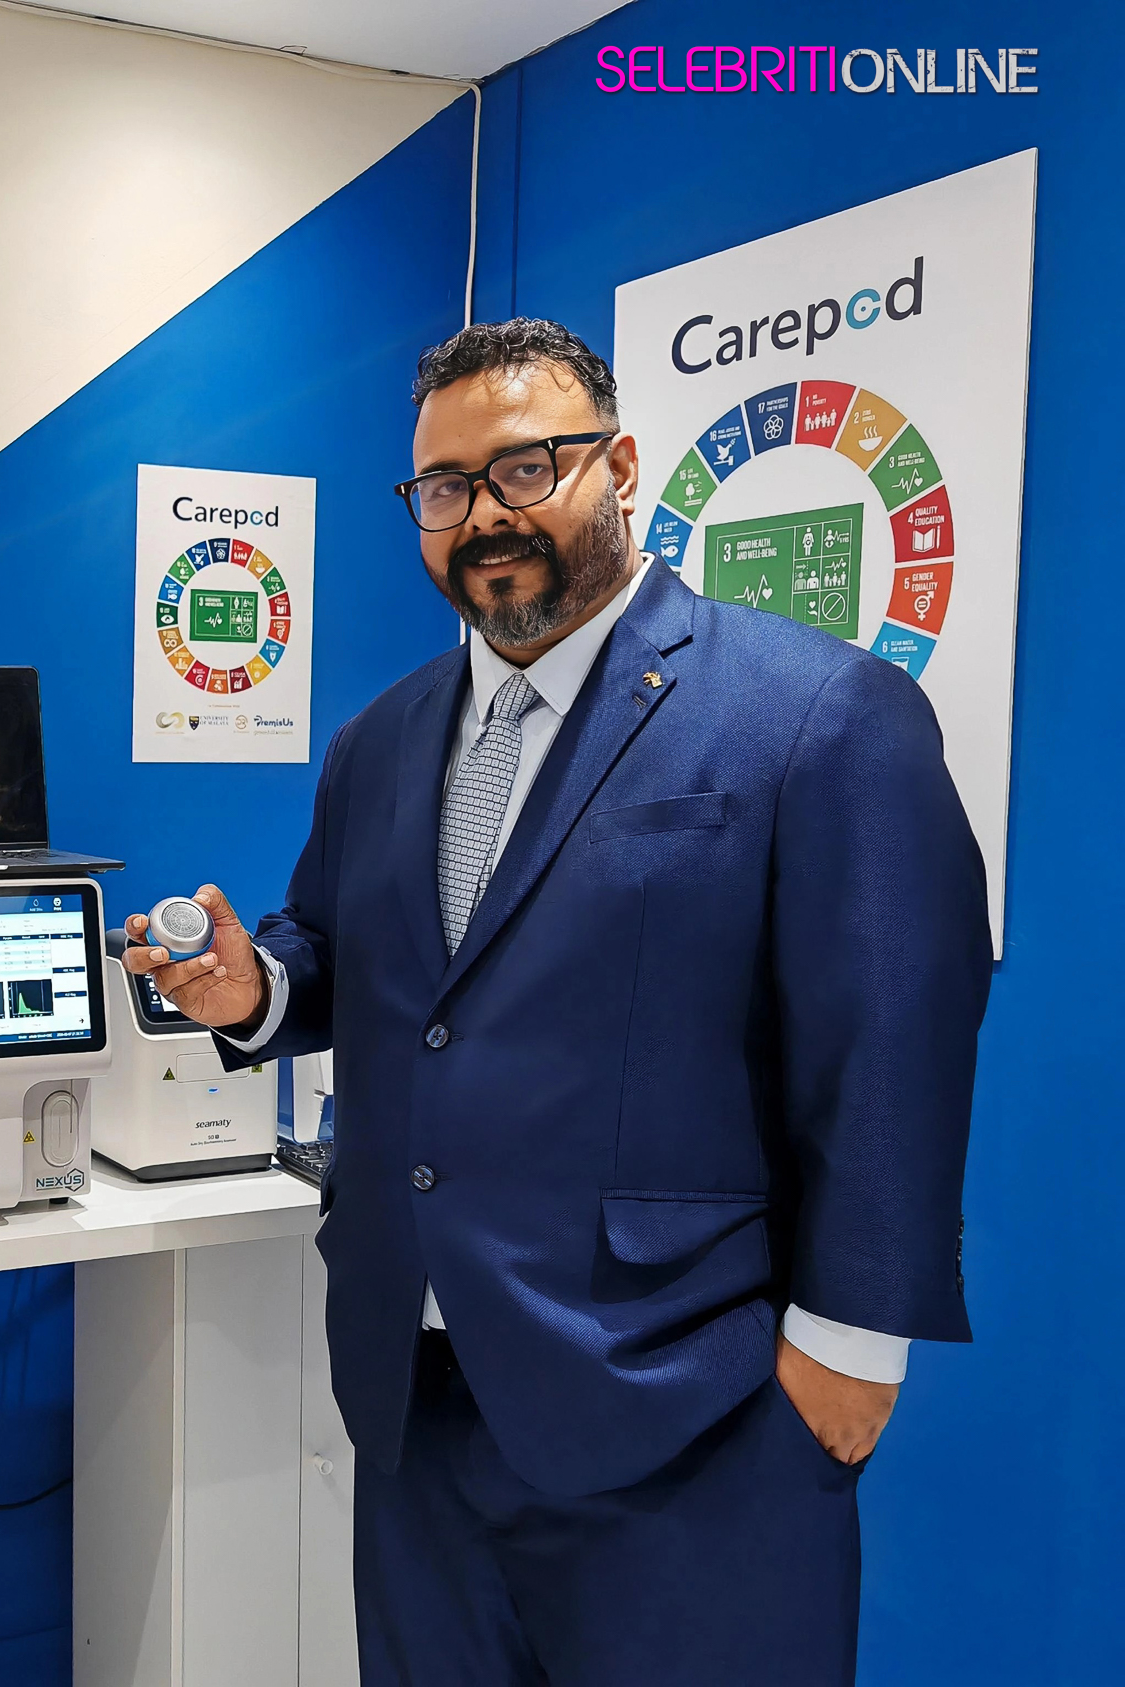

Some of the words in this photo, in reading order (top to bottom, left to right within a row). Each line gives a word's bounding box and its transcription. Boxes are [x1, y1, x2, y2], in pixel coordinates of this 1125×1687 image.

[805, 396, 810, 407] 1
[758, 402, 765, 414] 17
[853, 412, 860, 424] 2
[710, 430, 717, 442] 16
[889, 456, 895, 469] 3
[679, 469, 686, 480] 15
[915, 505, 938, 517] QUALITY
[907, 512, 914, 524] 4
[914, 515, 945, 526] EDUCATION
[656, 523, 663, 534] 14
[736, 540, 751, 551] GOOD
[751, 538, 771, 549] HEALTH
[723, 543, 731, 562] 3
[736, 551, 747, 561] AND
[747, 548, 777, 560] WELL-BEING
[912, 572, 934, 582] GENDER
[904, 577, 910, 590] 5
[911, 582, 938, 592] EQUALITY
[882, 640, 888, 653] 6
[195, 1119, 231, 1129] seamaty
[36, 1174, 82, 1188] NEXUS
